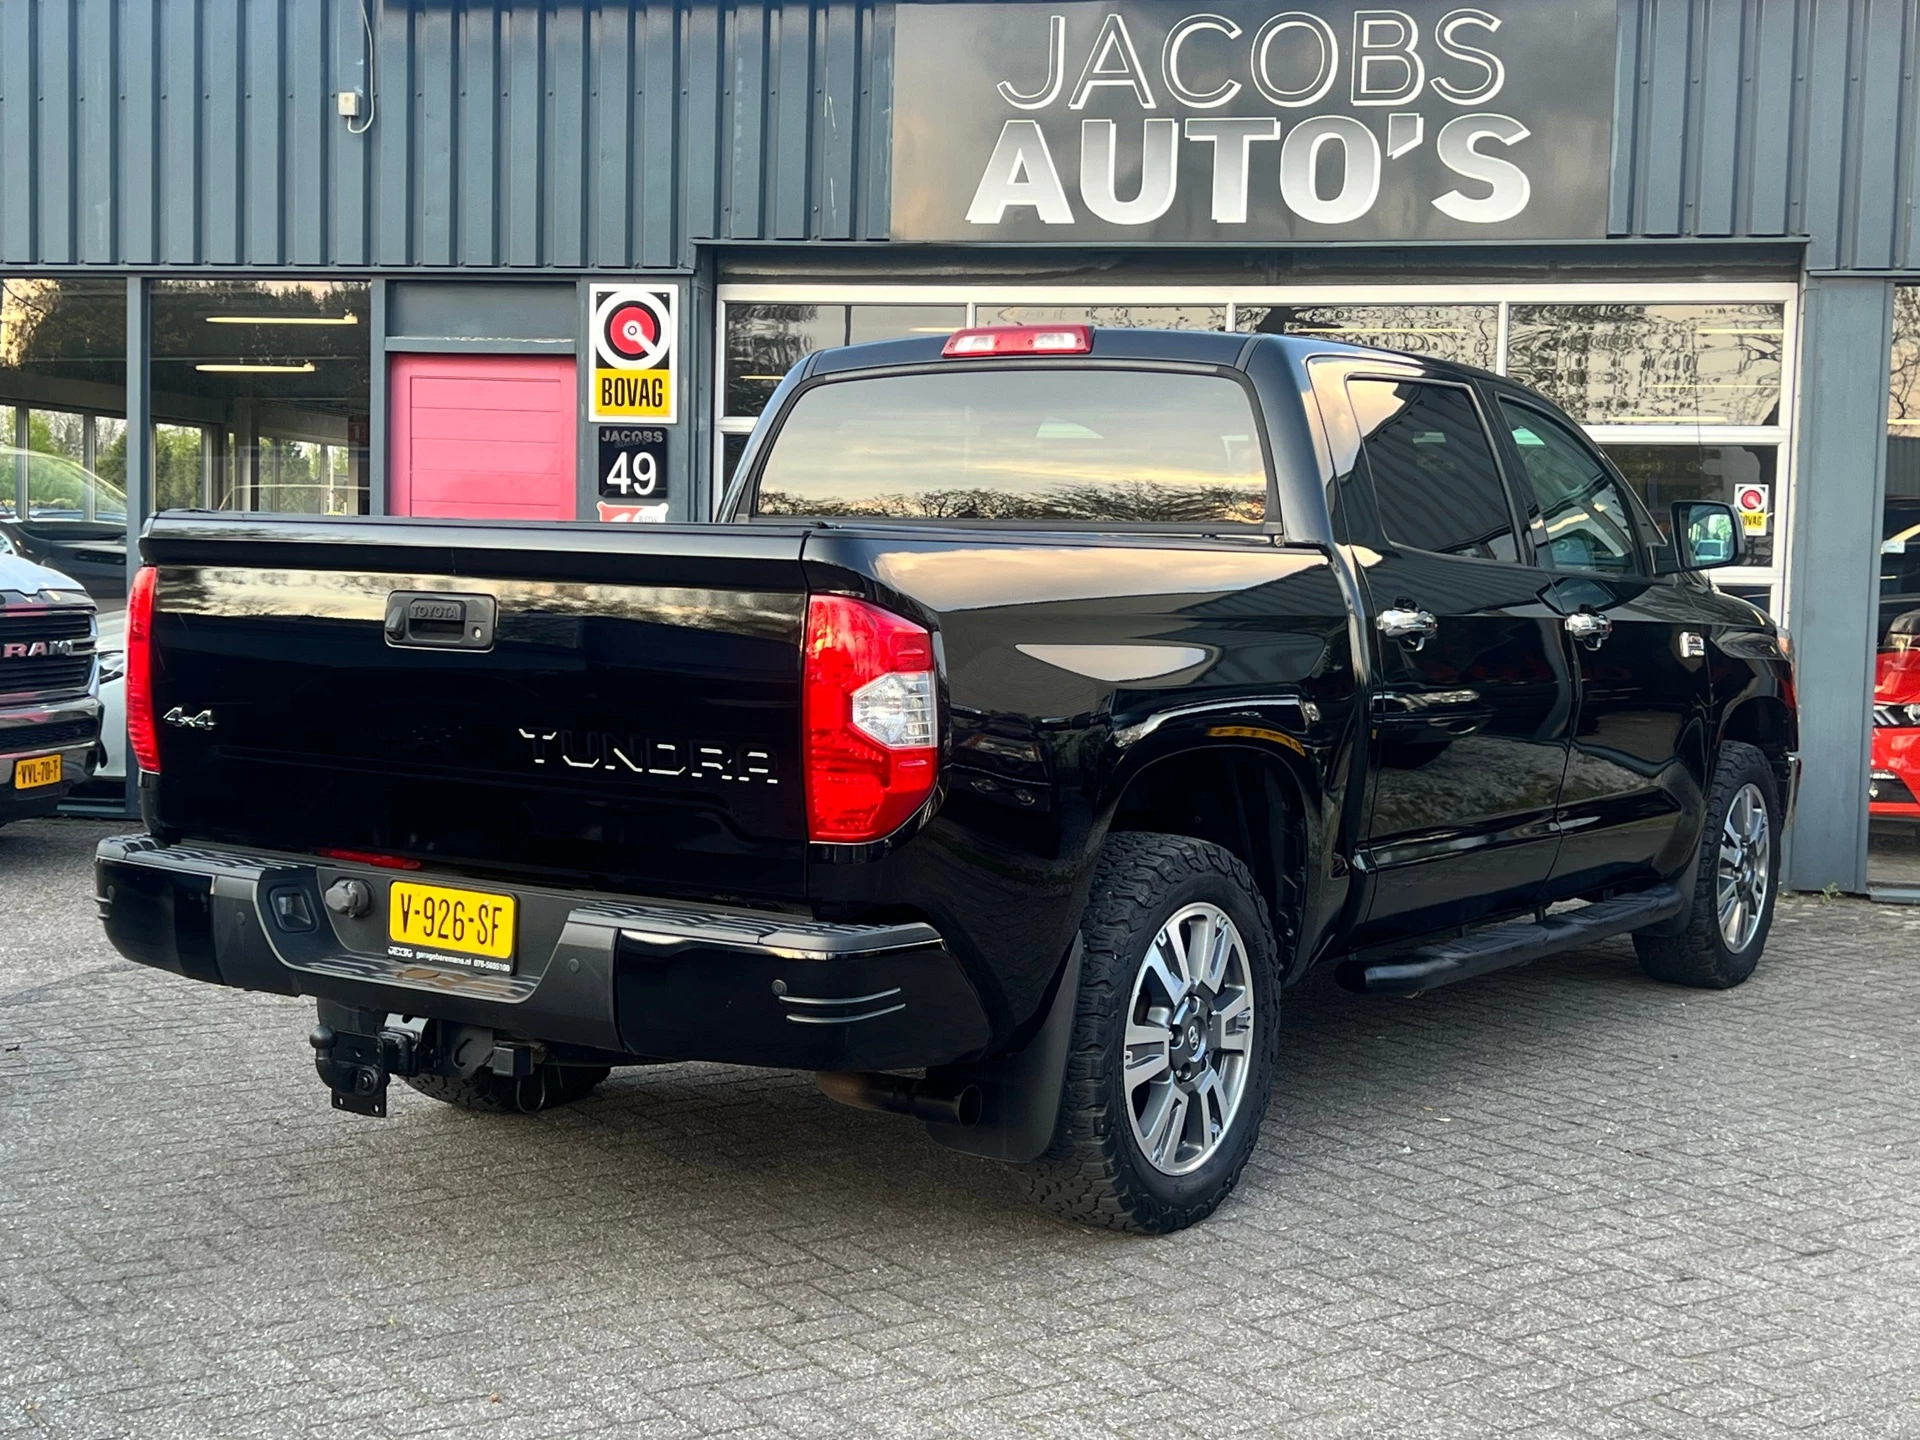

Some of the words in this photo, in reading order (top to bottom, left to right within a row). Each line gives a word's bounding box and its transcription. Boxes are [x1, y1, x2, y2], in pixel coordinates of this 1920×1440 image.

[996, 8, 1505, 110] JACOBS
[965, 113, 1531, 225] AUTO'S
[601, 377, 664, 407] BOVAG
[601, 429, 663, 443] JACOBS
[606, 451, 657, 496] 49
[1741, 515, 1762, 526] OVAG
[412, 604, 458, 619] TOYOTA
[3, 639, 72, 658] RAM
[518, 726, 779, 784] TUNDRA
[400, 893, 503, 947] V-926-SF
